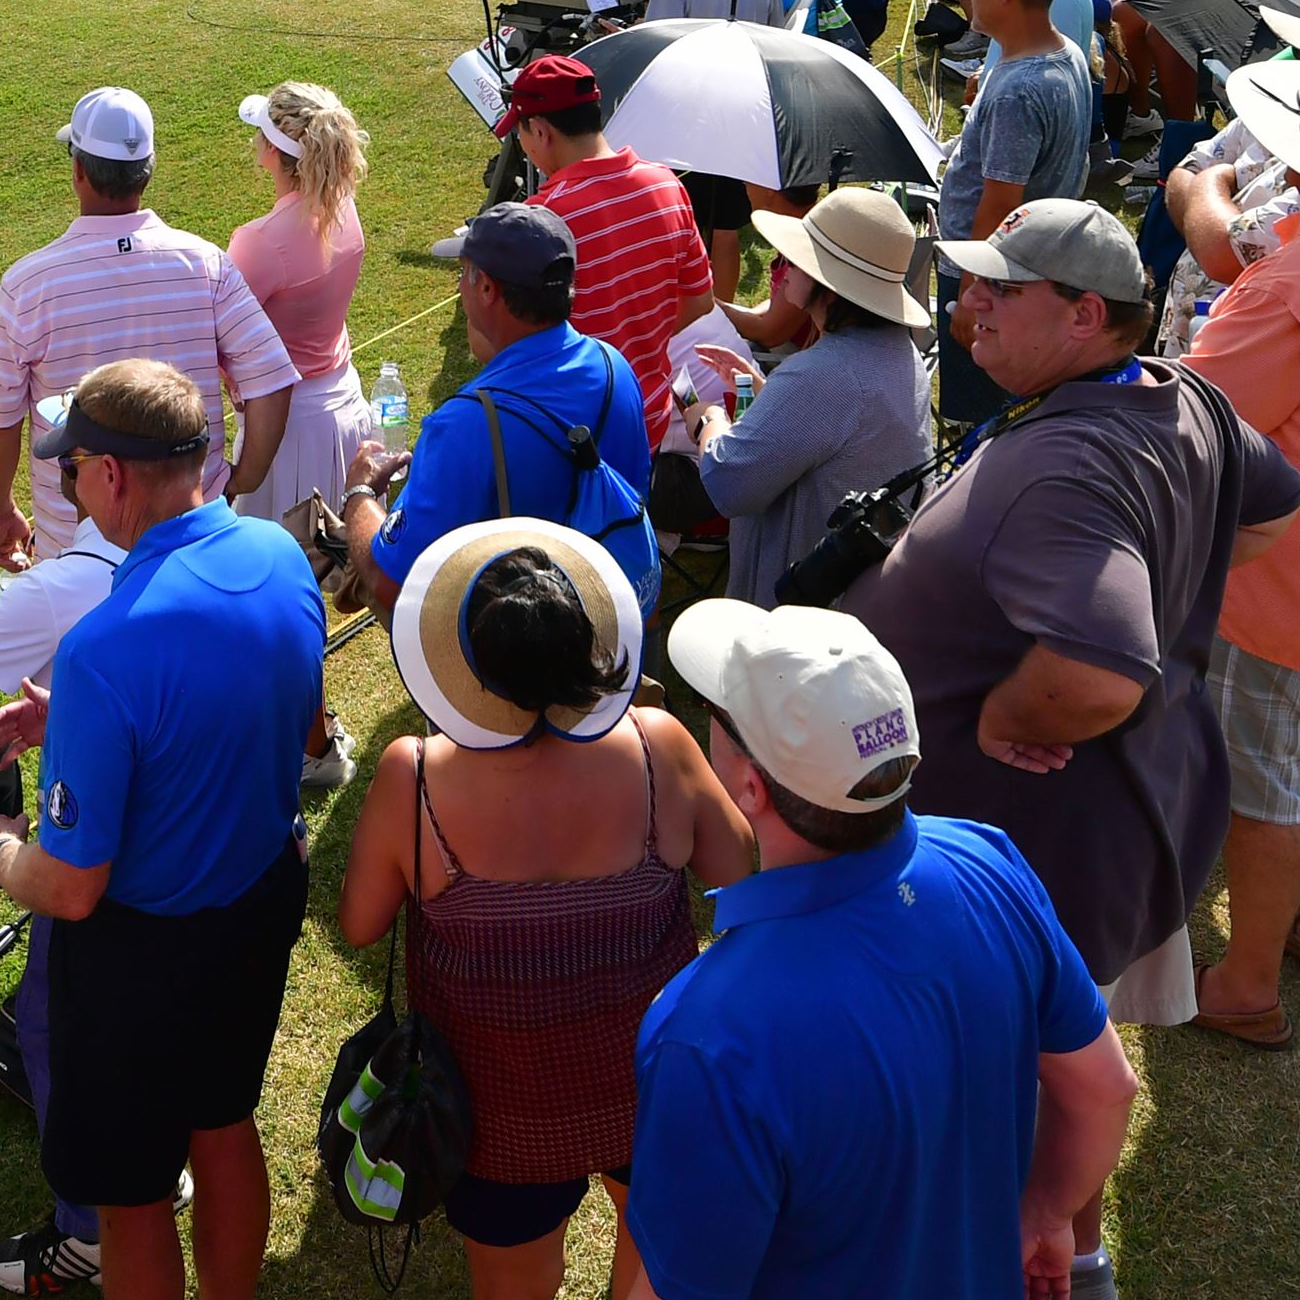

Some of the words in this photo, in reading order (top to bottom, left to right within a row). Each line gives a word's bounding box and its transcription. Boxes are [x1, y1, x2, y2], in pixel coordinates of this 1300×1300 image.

[117, 237, 132, 253] FJ
[854, 715, 904, 744] PLANO
[857, 724, 909, 754] BALLOON
